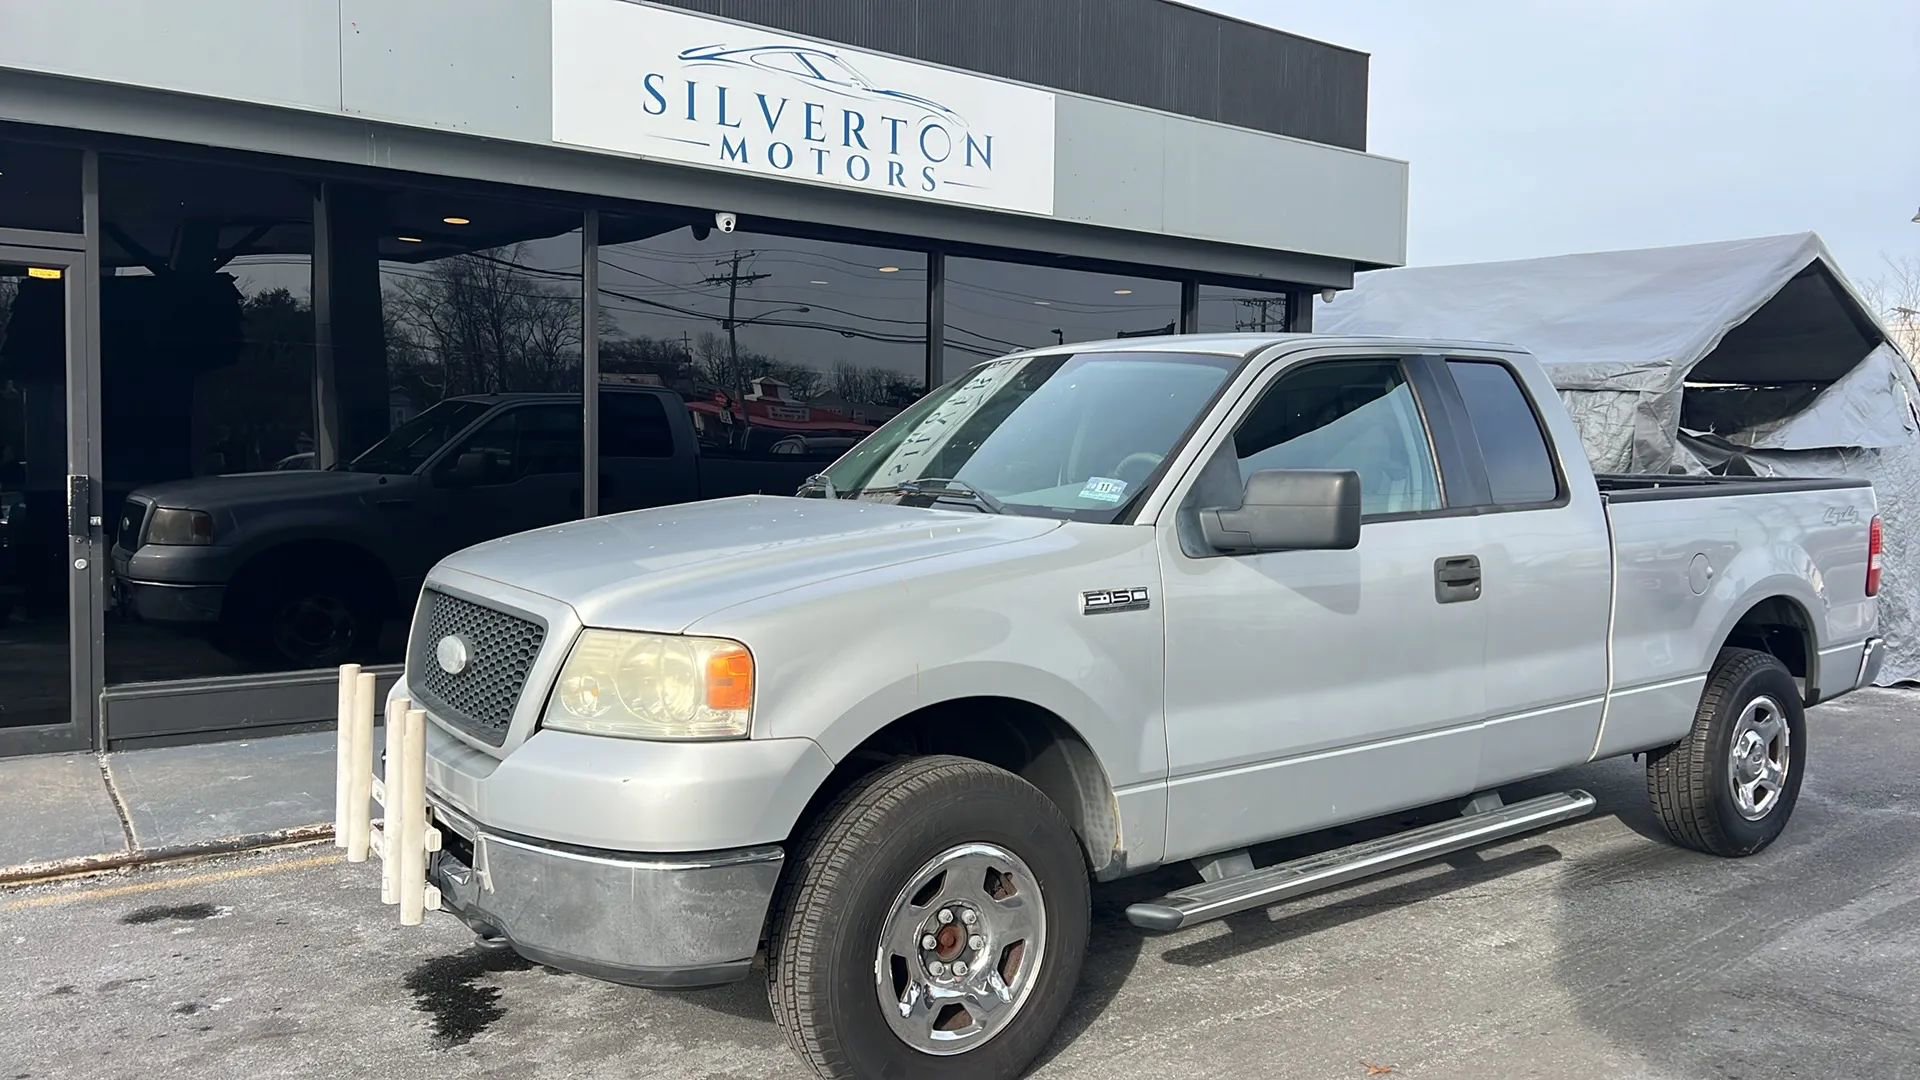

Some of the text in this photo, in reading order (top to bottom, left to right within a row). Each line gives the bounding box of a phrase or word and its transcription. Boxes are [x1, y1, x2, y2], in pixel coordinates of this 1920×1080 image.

[643, 73, 994, 170] SILVERTON
[719, 134, 937, 192] MOTORS
[1083, 587, 1149, 607] F-150
